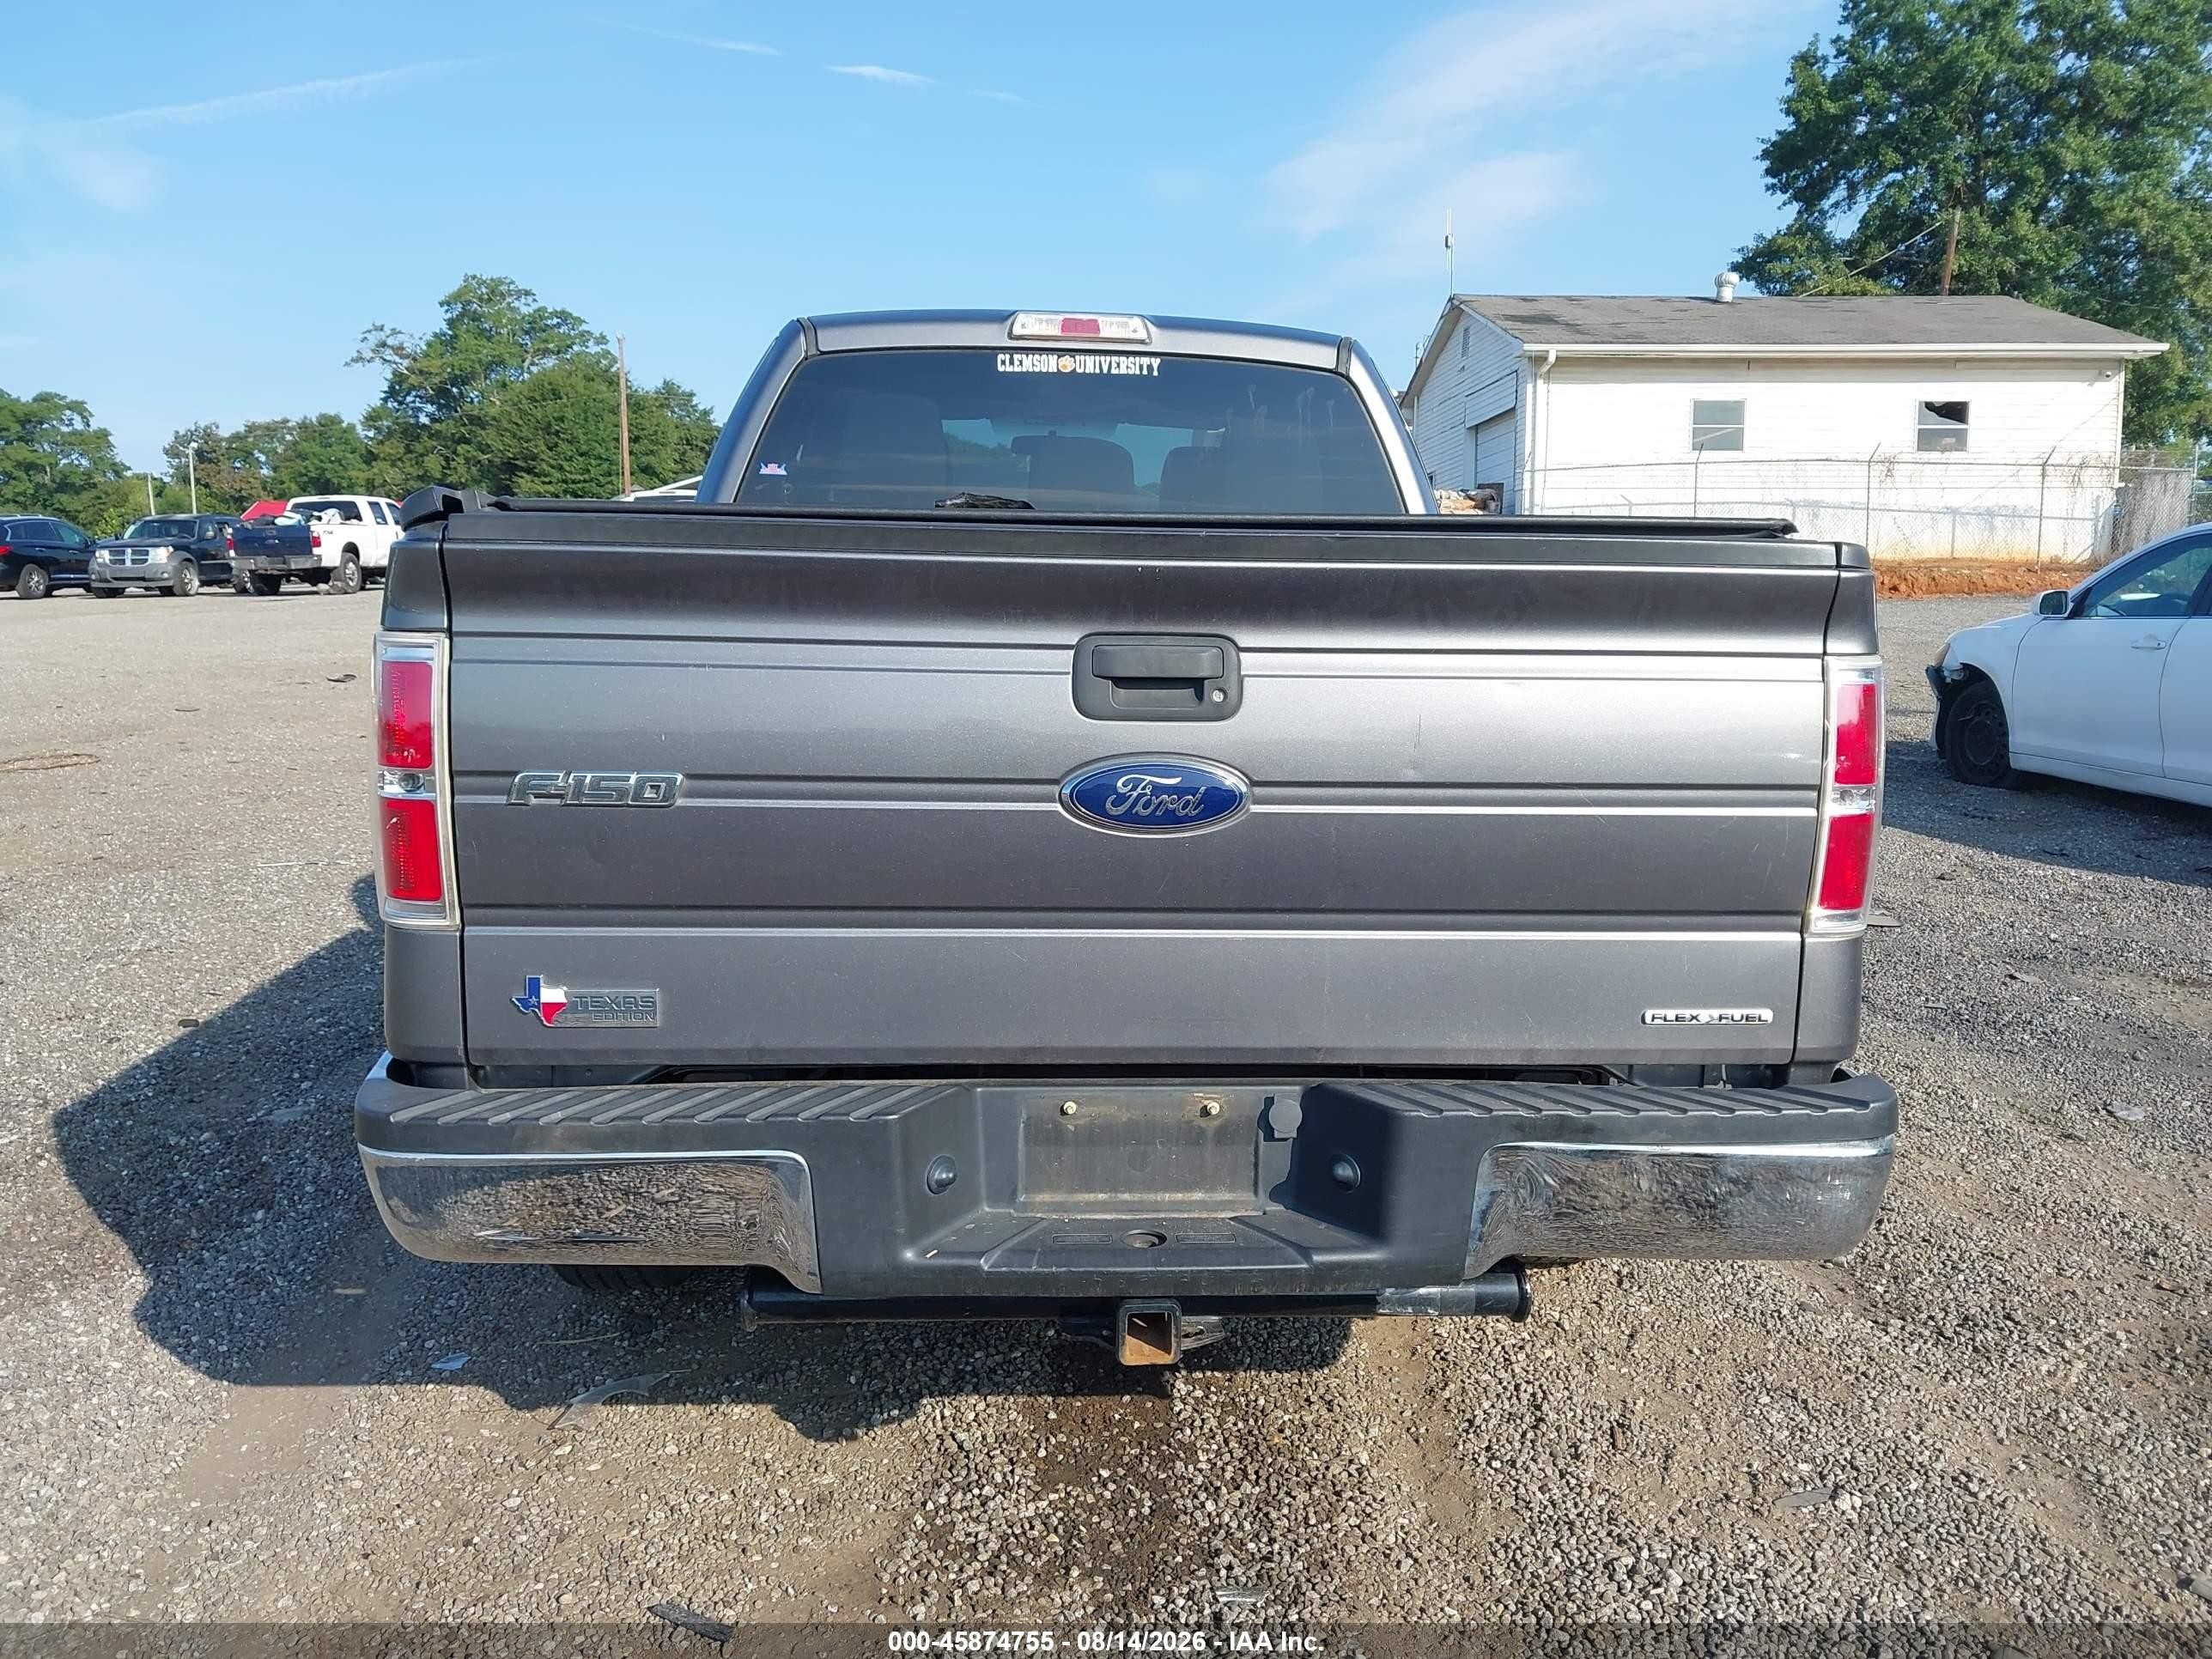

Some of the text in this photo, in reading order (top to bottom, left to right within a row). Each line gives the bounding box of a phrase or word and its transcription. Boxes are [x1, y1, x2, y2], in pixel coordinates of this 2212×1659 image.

[997, 353, 1161, 376] CLEMSON UNIVERSITY
[505, 770, 687, 808] F-150
[1105, 774, 1207, 817] Ford
[573, 995, 656, 1010] TEXAS
[592, 1012, 655, 1022] EDITION
[1650, 1013, 1768, 1023] FLEX FUEL
